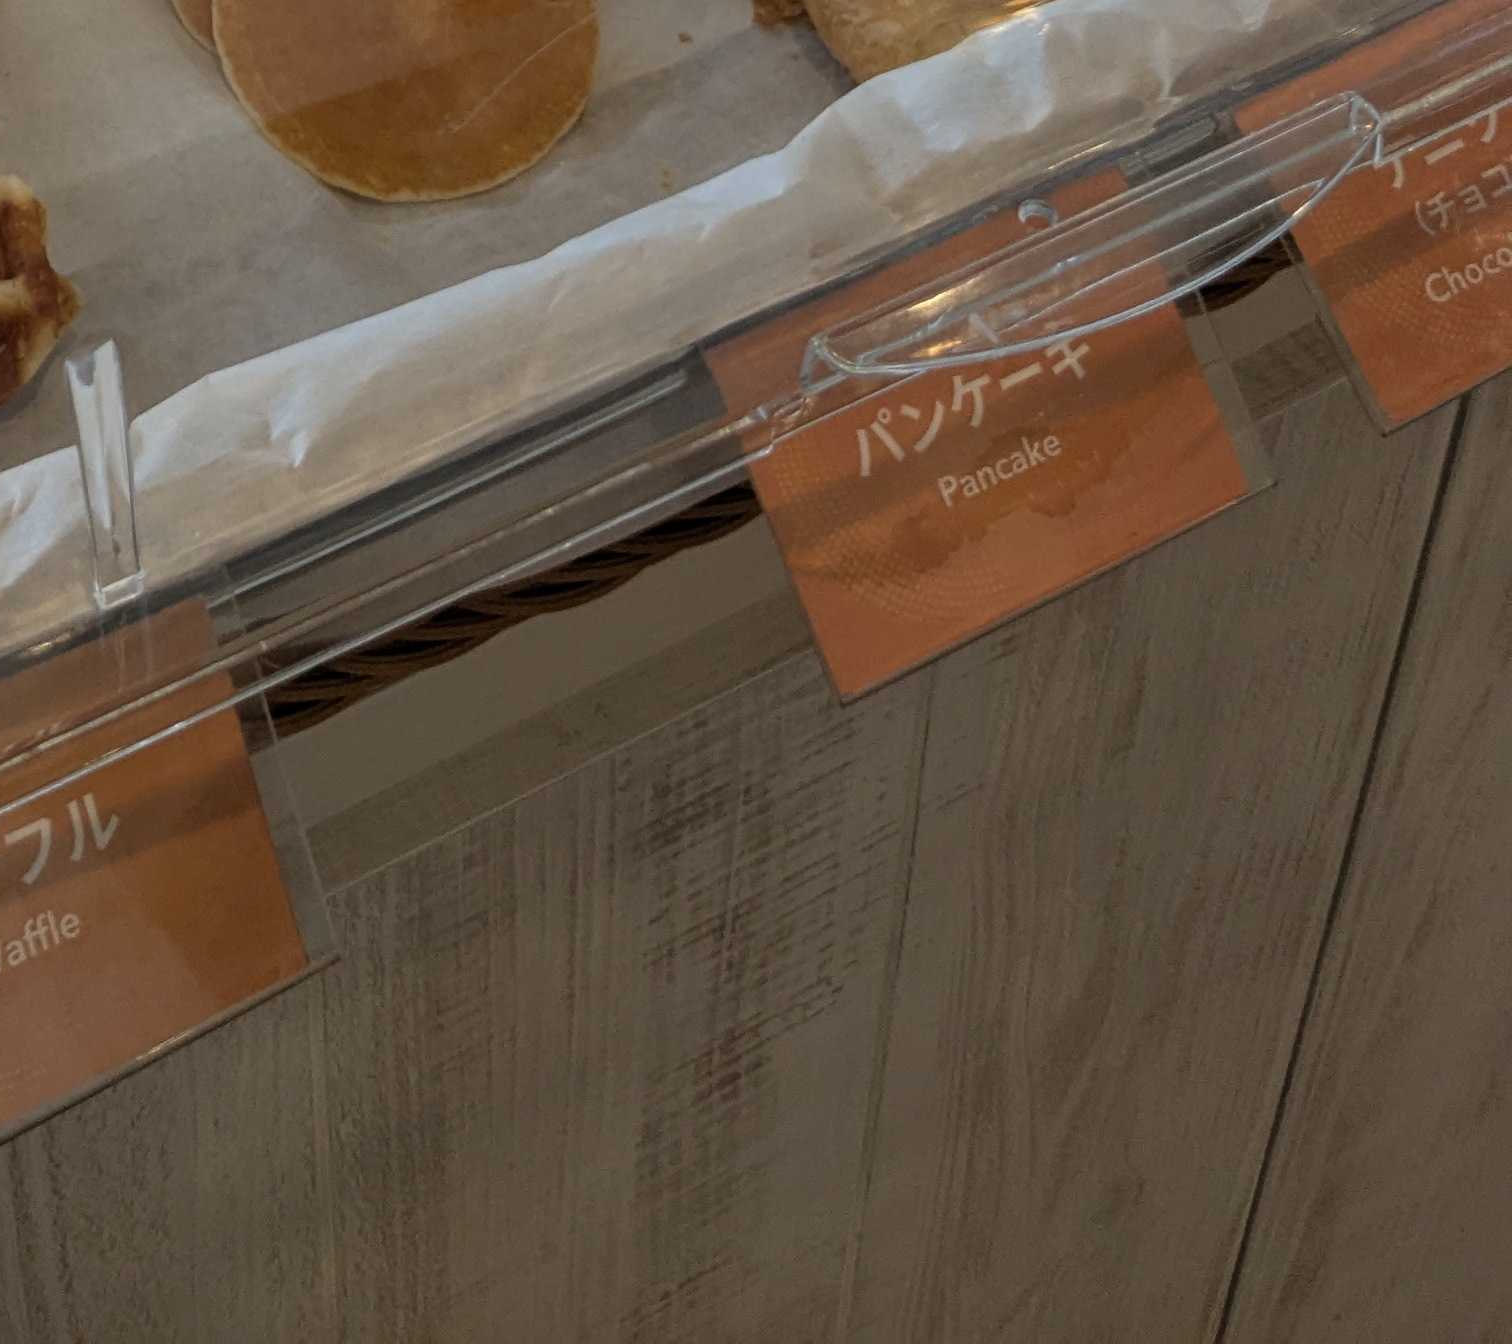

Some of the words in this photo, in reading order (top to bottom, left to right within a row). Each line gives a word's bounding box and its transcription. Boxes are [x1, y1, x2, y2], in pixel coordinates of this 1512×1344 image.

[855, 337, 1092, 477] パンケーキ
[937, 433, 1063, 508] Pancake
